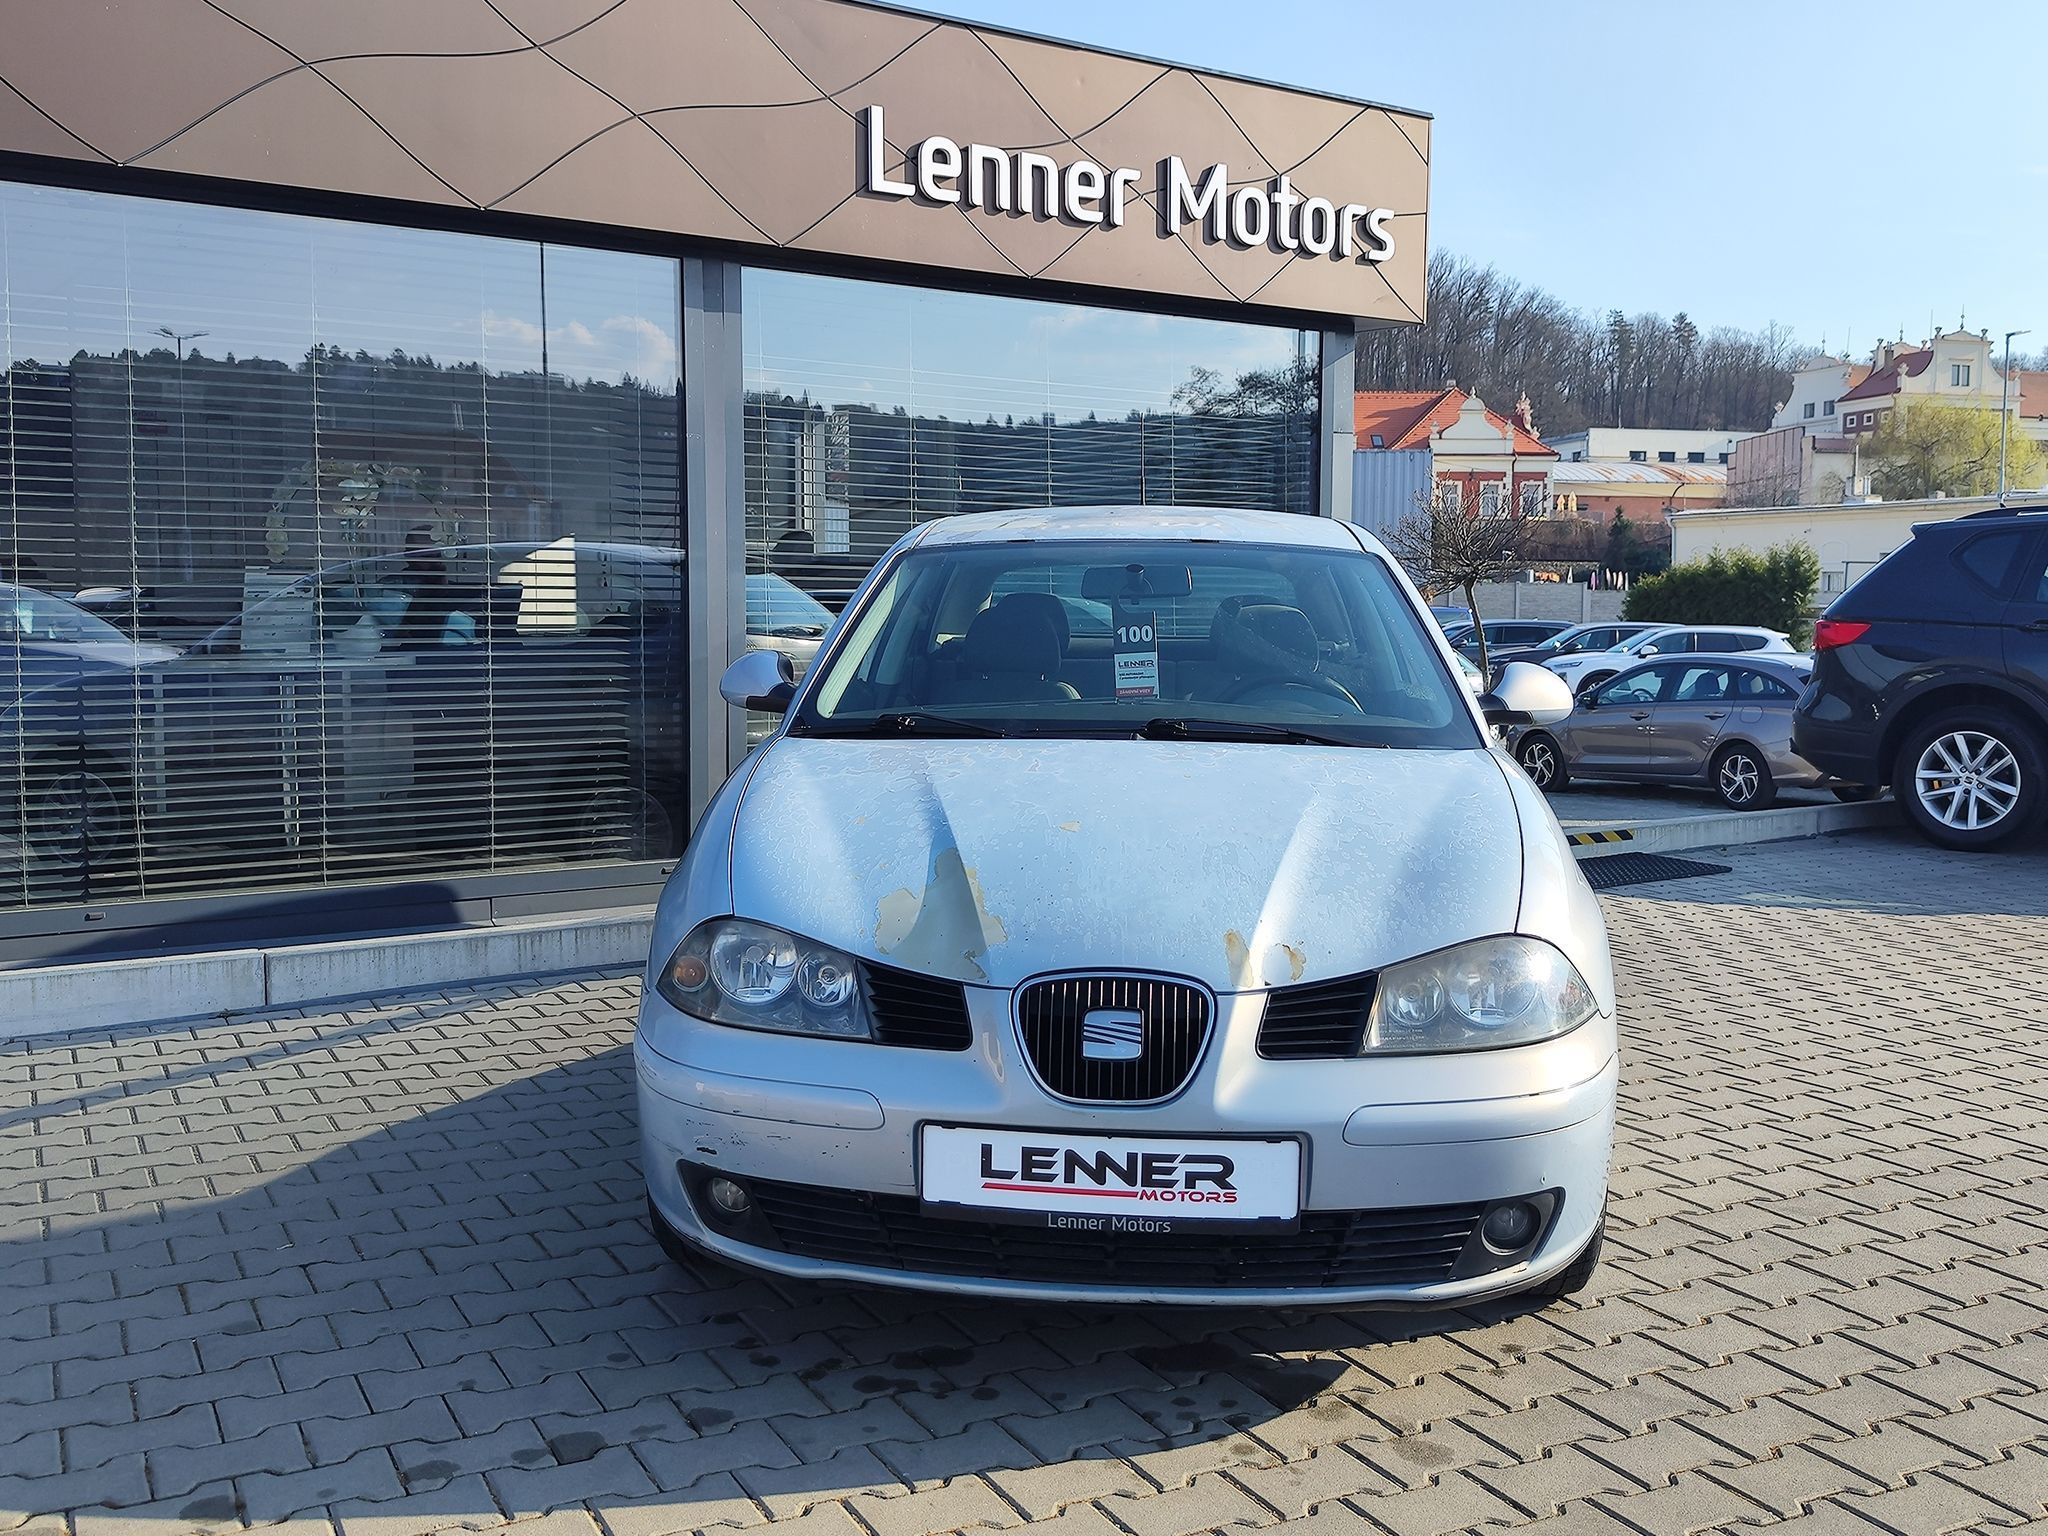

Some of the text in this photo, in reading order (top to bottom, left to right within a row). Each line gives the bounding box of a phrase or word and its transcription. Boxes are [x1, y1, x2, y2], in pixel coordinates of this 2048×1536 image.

[864, 104, 1397, 263] Lenner Motors
[1117, 625, 1153, 643] 100
[980, 1143, 1237, 1189] LENNER
[1138, 1190, 1238, 1203] MOTORS
[1048, 1213, 1172, 1233] Lenner Motors
